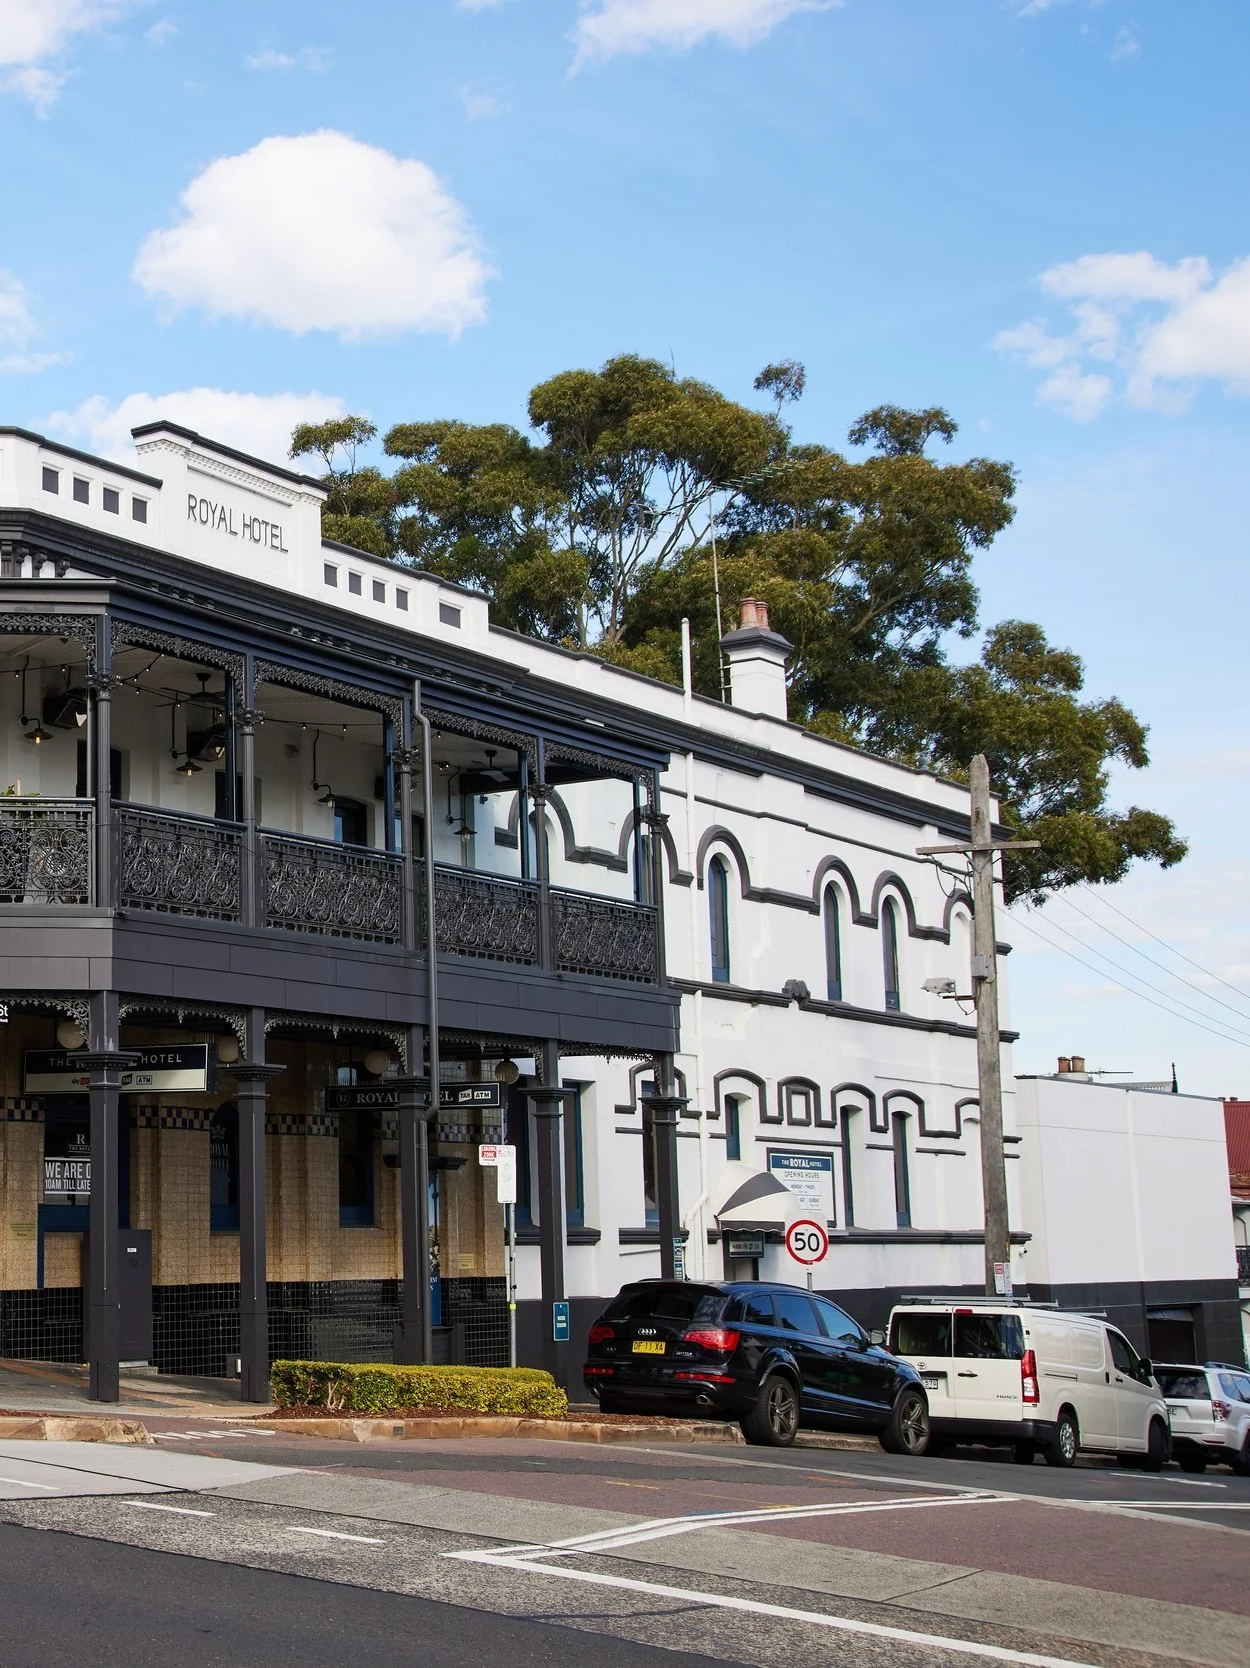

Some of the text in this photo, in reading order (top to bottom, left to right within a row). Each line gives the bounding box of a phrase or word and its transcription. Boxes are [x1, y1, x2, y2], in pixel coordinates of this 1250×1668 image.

[187, 493, 289, 553] ROYAL HOTEL
[49, 1057, 72, 1067] THE
[141, 1053, 182, 1064] HOTEL
[44, 1162, 61, 1178] WE
[63, 1162, 83, 1179] ARE
[790, 1158, 810, 1168] ROYAL
[45, 1179, 91, 1190] 10AM TILL LATE
[794, 1232, 820, 1252] 50
